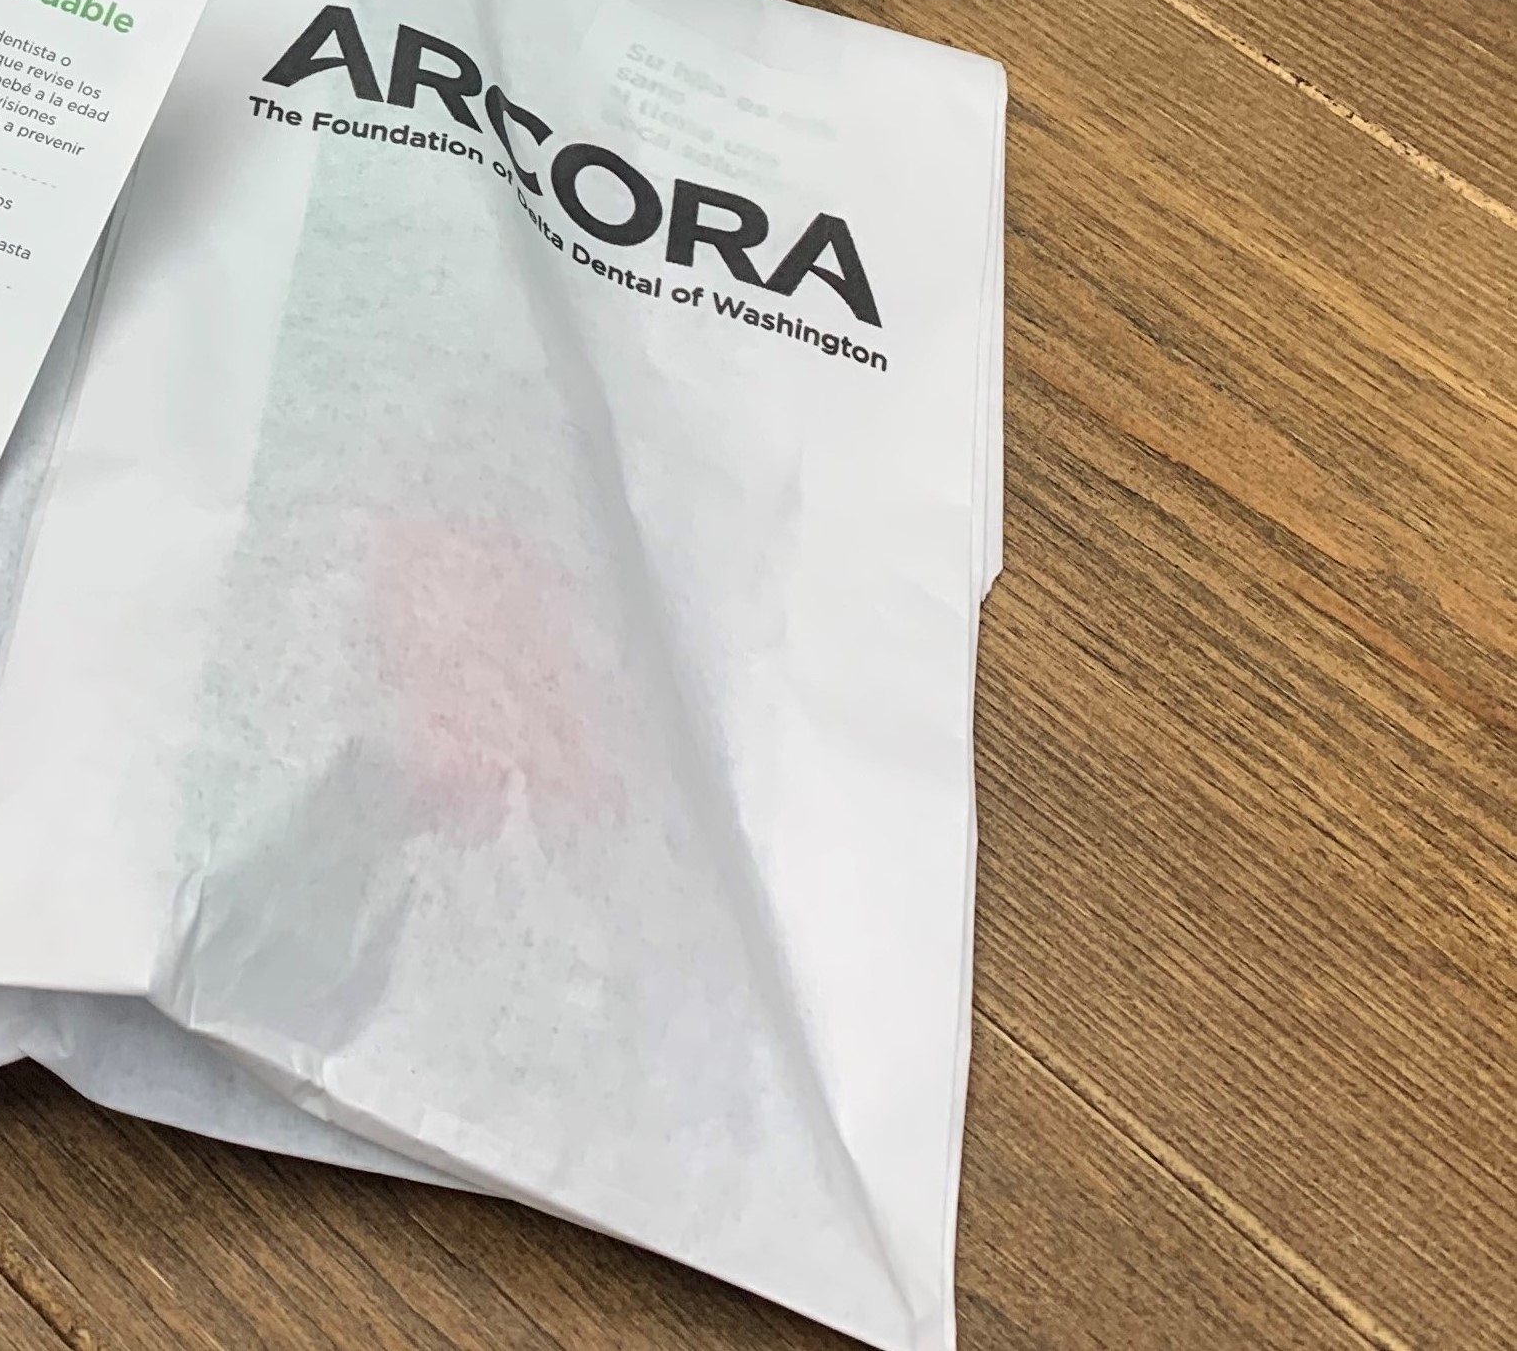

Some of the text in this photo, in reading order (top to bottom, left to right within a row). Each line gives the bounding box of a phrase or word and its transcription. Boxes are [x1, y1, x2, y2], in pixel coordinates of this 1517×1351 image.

[60, 55, 71, 67] o
[27, 65, 74, 89] revise
[78, 81, 101, 100] los
[3, 121, 14, 133] a
[17, 125, 85, 156] prevenir
[261, 4, 883, 329] ARCORA
[249, 95, 302, 126] The
[312, 111, 483, 165] Foundation
[517, 186, 563, 252] Delta
[572, 243, 661, 298] Dental
[671, 286, 705, 307] of
[712, 291, 888, 372] Washington
